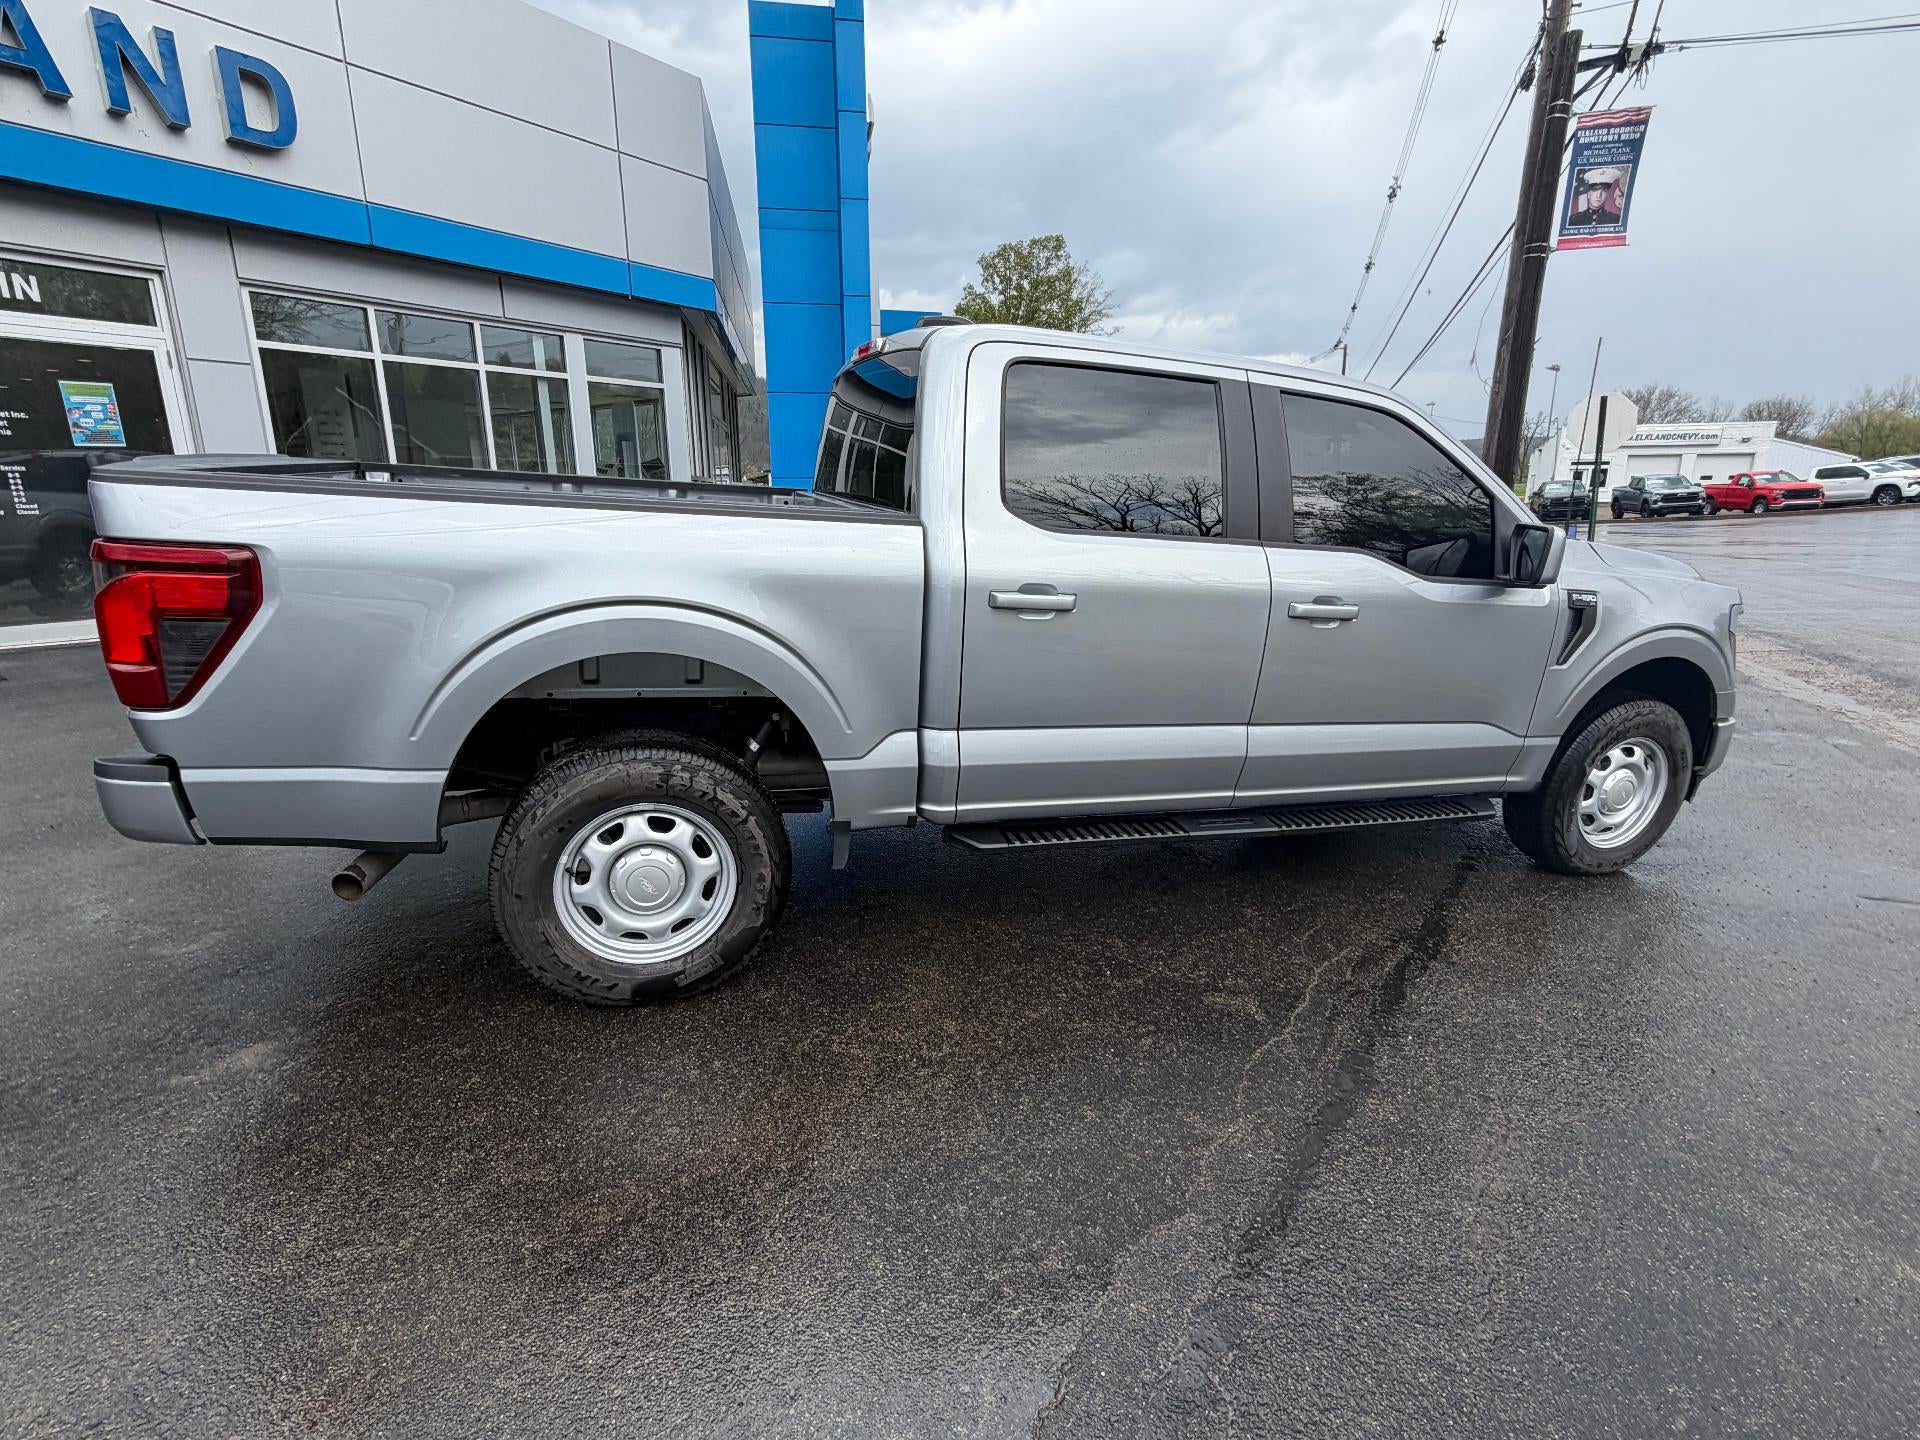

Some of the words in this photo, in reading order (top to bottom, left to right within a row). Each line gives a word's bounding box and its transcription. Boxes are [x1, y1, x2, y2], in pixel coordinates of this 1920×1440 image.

[1577, 128, 1608, 137] ELKLAND
[1609, 124, 1645, 135] BOROUGH
[1579, 134, 1619, 144] HOMETOWN
[1620, 132, 1641, 140] HERO
[1613, 154, 1634, 162] CORPS
[10, 410, 29, 419] Inc.
